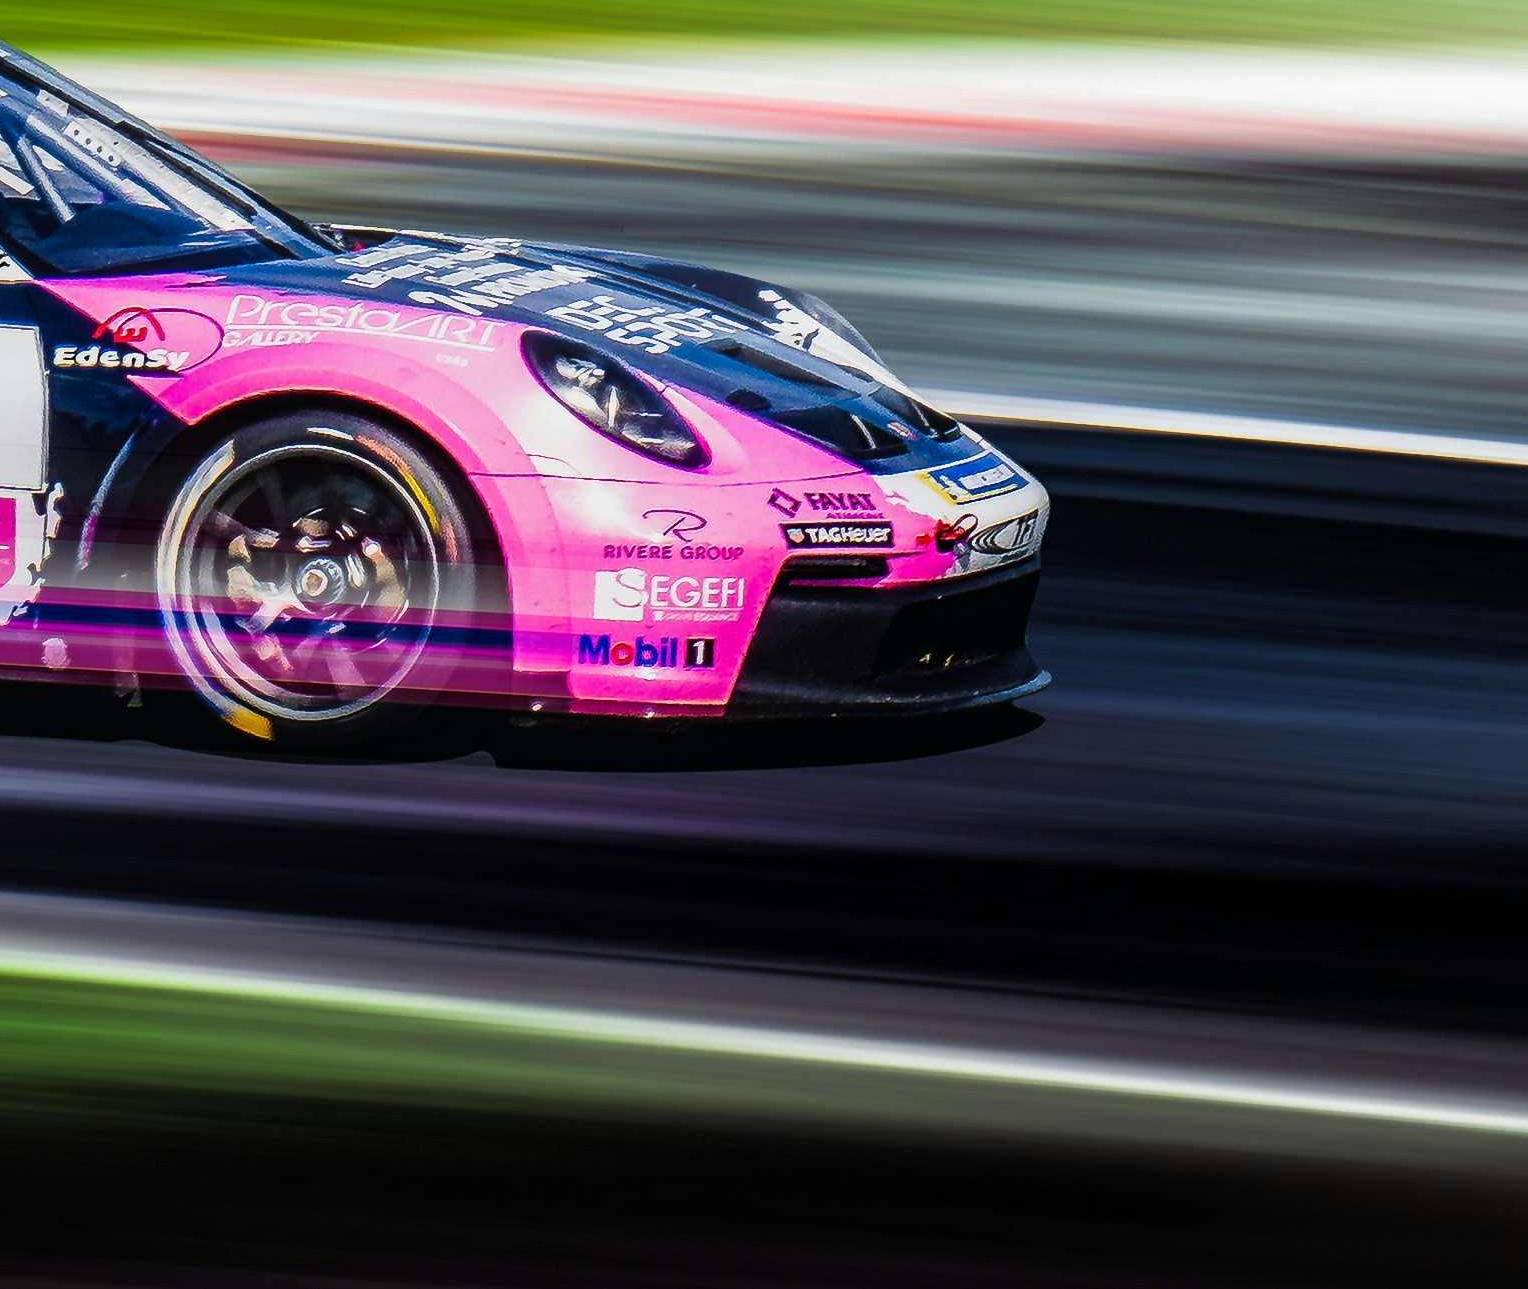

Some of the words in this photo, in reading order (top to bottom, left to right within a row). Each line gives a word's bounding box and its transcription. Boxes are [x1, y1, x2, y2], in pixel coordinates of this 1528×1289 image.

[53, 345, 192, 371] EdenSy
[804, 492, 877, 511] FAYAT
[603, 544, 673, 560] RIVERE
[680, 545, 745, 561] GROUP
[613, 567, 746, 609] SEGEFI
[577, 633, 679, 668] Mobil
